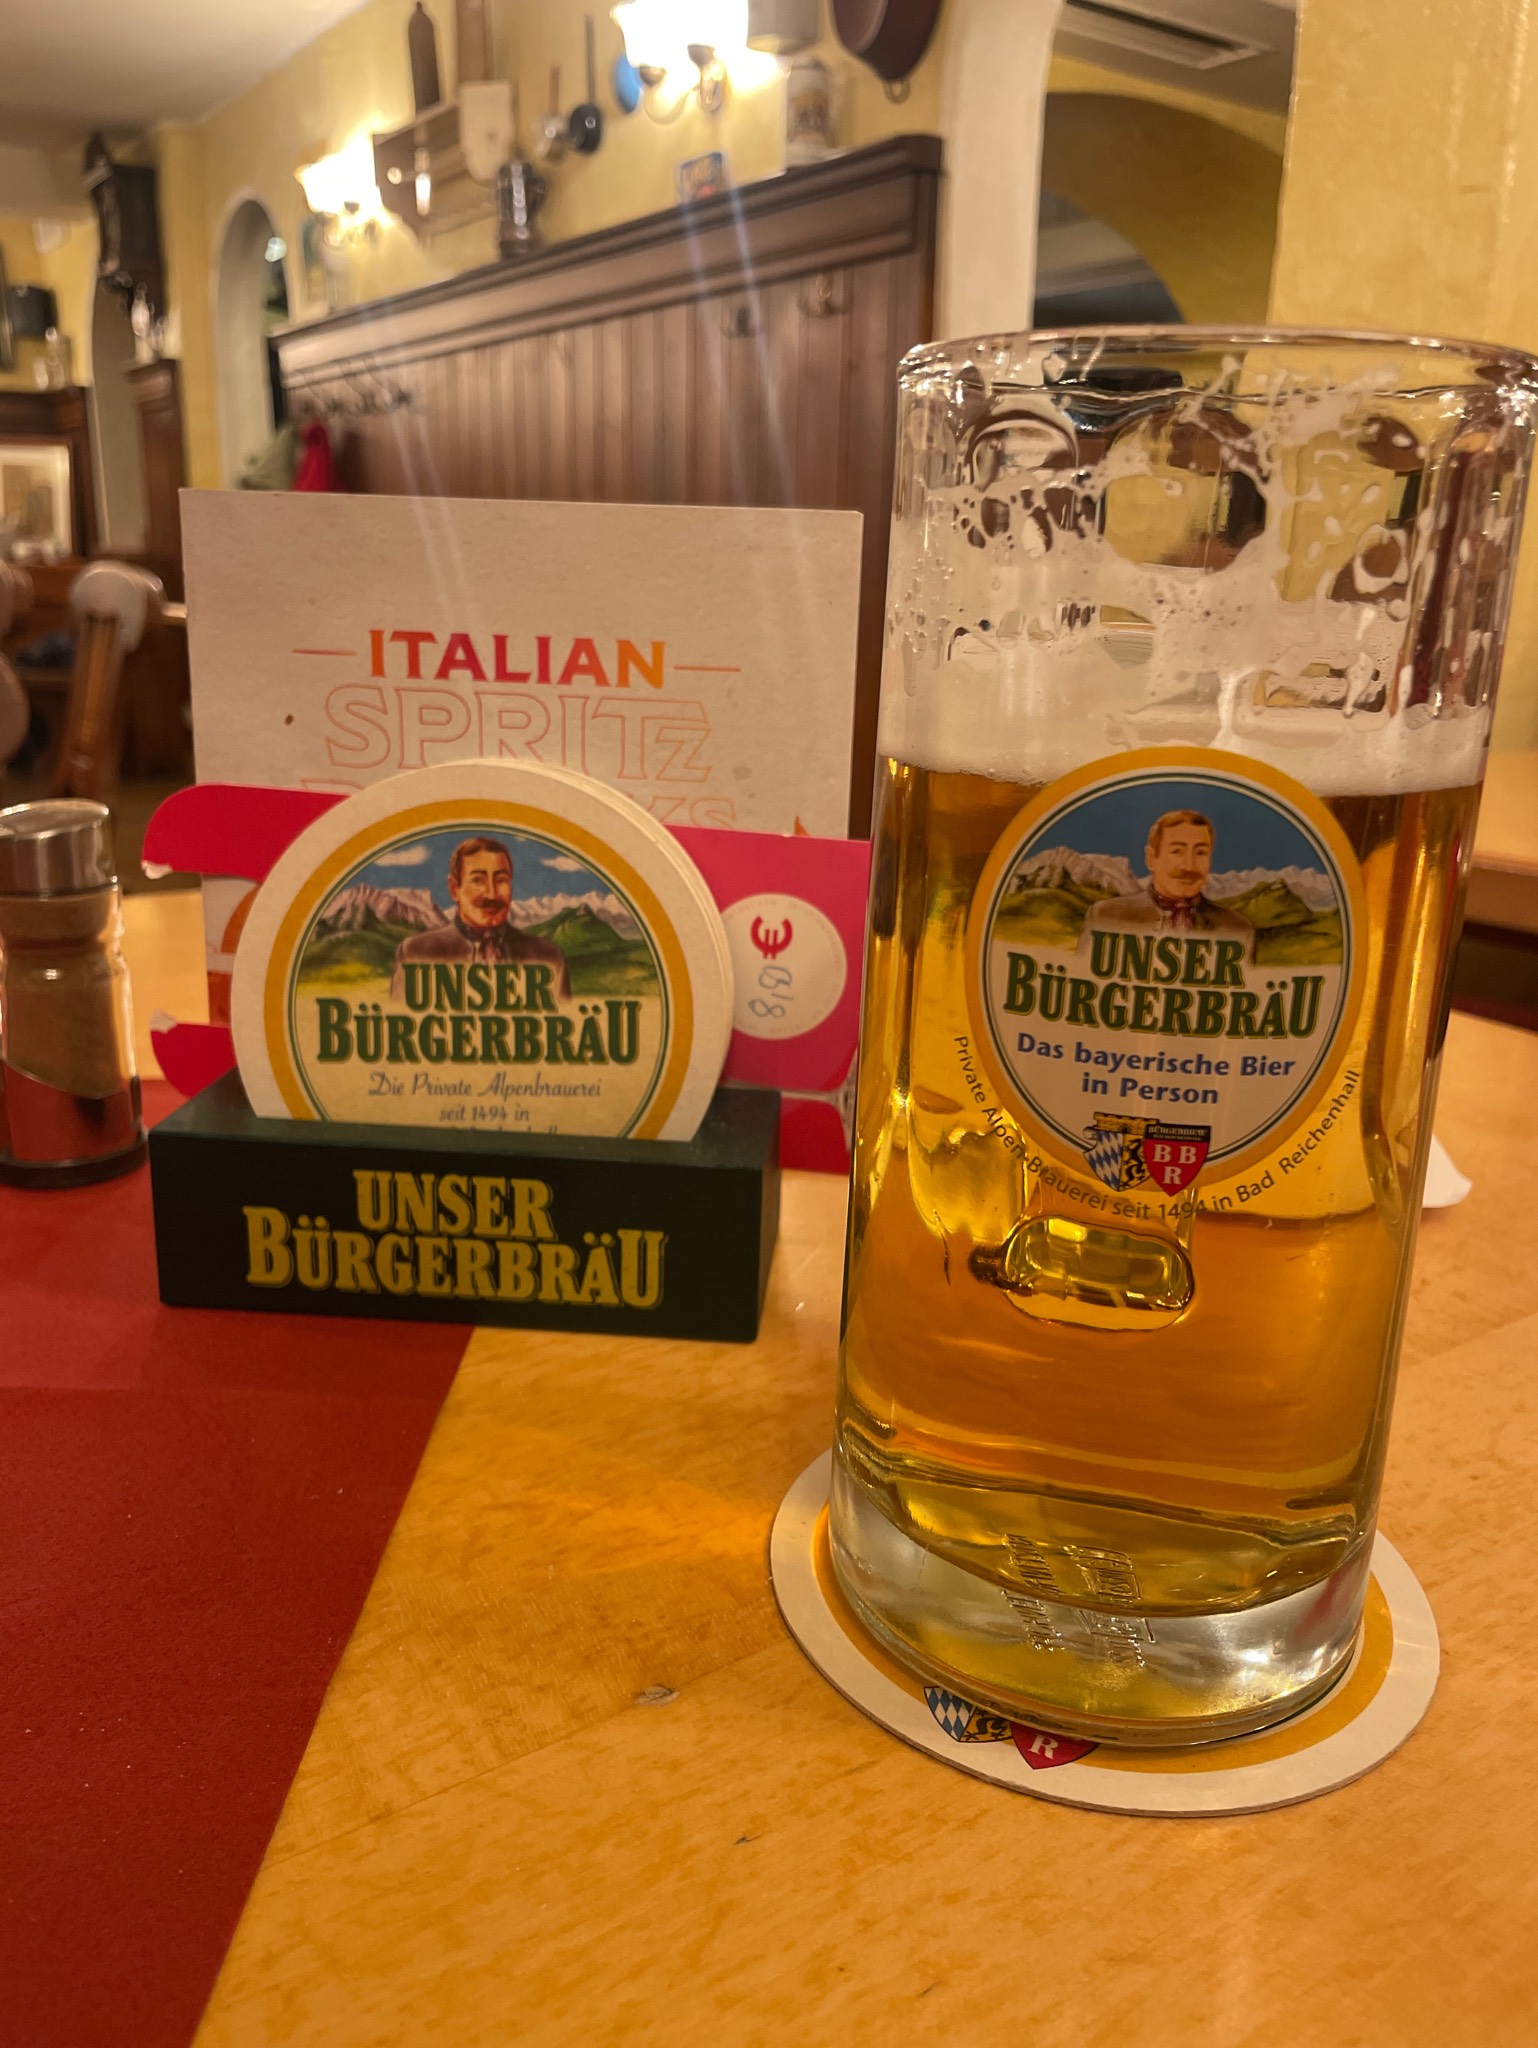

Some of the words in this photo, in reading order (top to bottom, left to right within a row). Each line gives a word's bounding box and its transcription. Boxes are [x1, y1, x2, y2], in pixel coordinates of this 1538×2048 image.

[369, 629, 666, 689] ITALIAN
[325, 684, 712, 783] SPRITZ
[402, 963, 558, 1013] UNSER
[1090, 930, 1246, 989] UNSER
[1003, 952, 1325, 1039] BÜRGERBRÄU
[316, 997, 643, 1065] BÜRGERBRÄU
[1017, 1032, 1064, 1059] Das
[1074, 1042, 1229, 1075] bayerische
[1240, 1056, 1295, 1077] Bier
[368, 1070, 405, 1097] Die
[412, 1070, 473, 1098] Private
[477, 1071, 603, 1101] Alpenbrauerei
[440, 1103, 466, 1121] seit
[515, 1102, 530, 1121] in
[1082, 1072, 1108, 1095] in
[1120, 1077, 1219, 1105] Person
[954, 1035, 987, 1105] Private
[1111, 1202, 1151, 1221] seit
[1158, 1199, 1208, 1221] 1494
[1212, 1196, 1234, 1212] in
[1235, 1170, 1276, 1204] Bad
[1278, 1069, 1361, 1175] Reichenhall
[1162, 1165, 1183, 1185] R
[354, 1169, 558, 1241] UNSER
[242, 1205, 670, 1310] BÜRGERBRÄU
[1028, 1732, 1060, 1760] R
